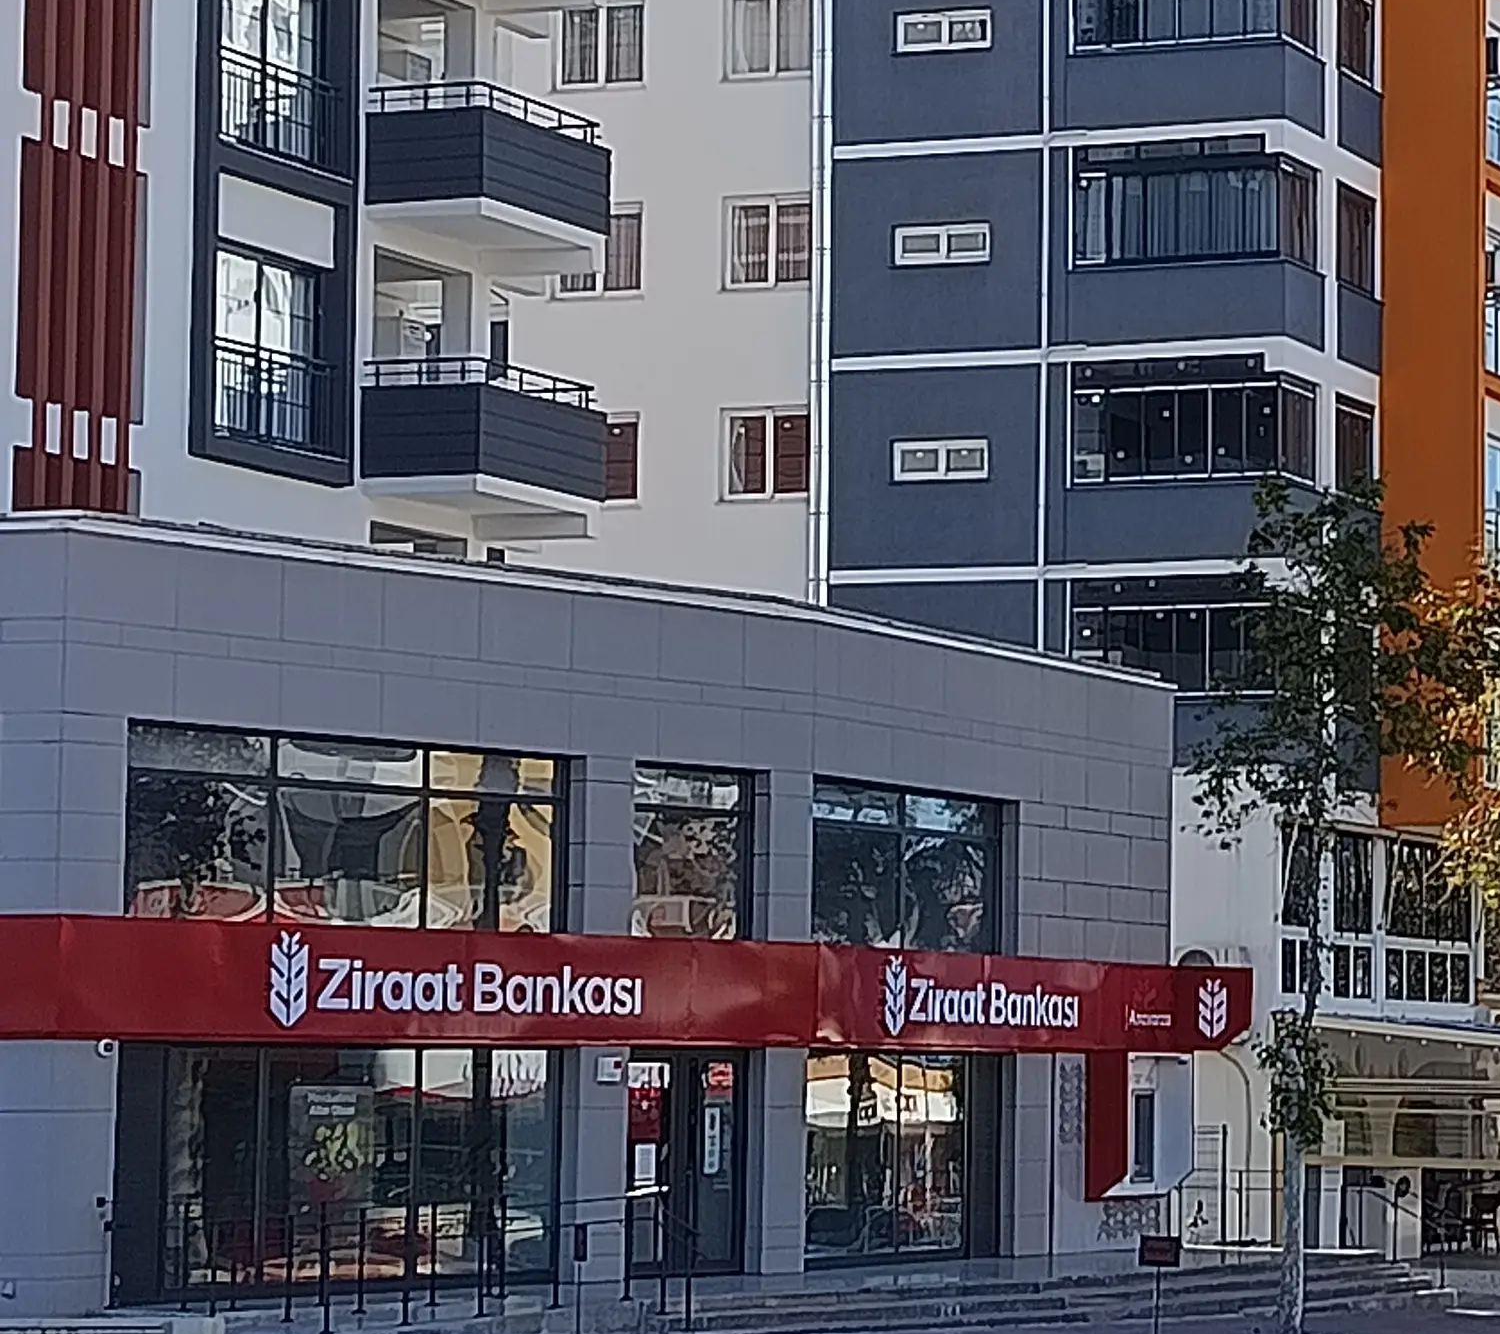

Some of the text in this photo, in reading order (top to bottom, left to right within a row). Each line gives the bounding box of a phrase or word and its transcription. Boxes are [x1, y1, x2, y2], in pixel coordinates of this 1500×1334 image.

[317, 959, 643, 1016] Ziraat Bankası
[909, 978, 986, 1024] Ziraat
[989, 981, 1079, 1028] Bankası
